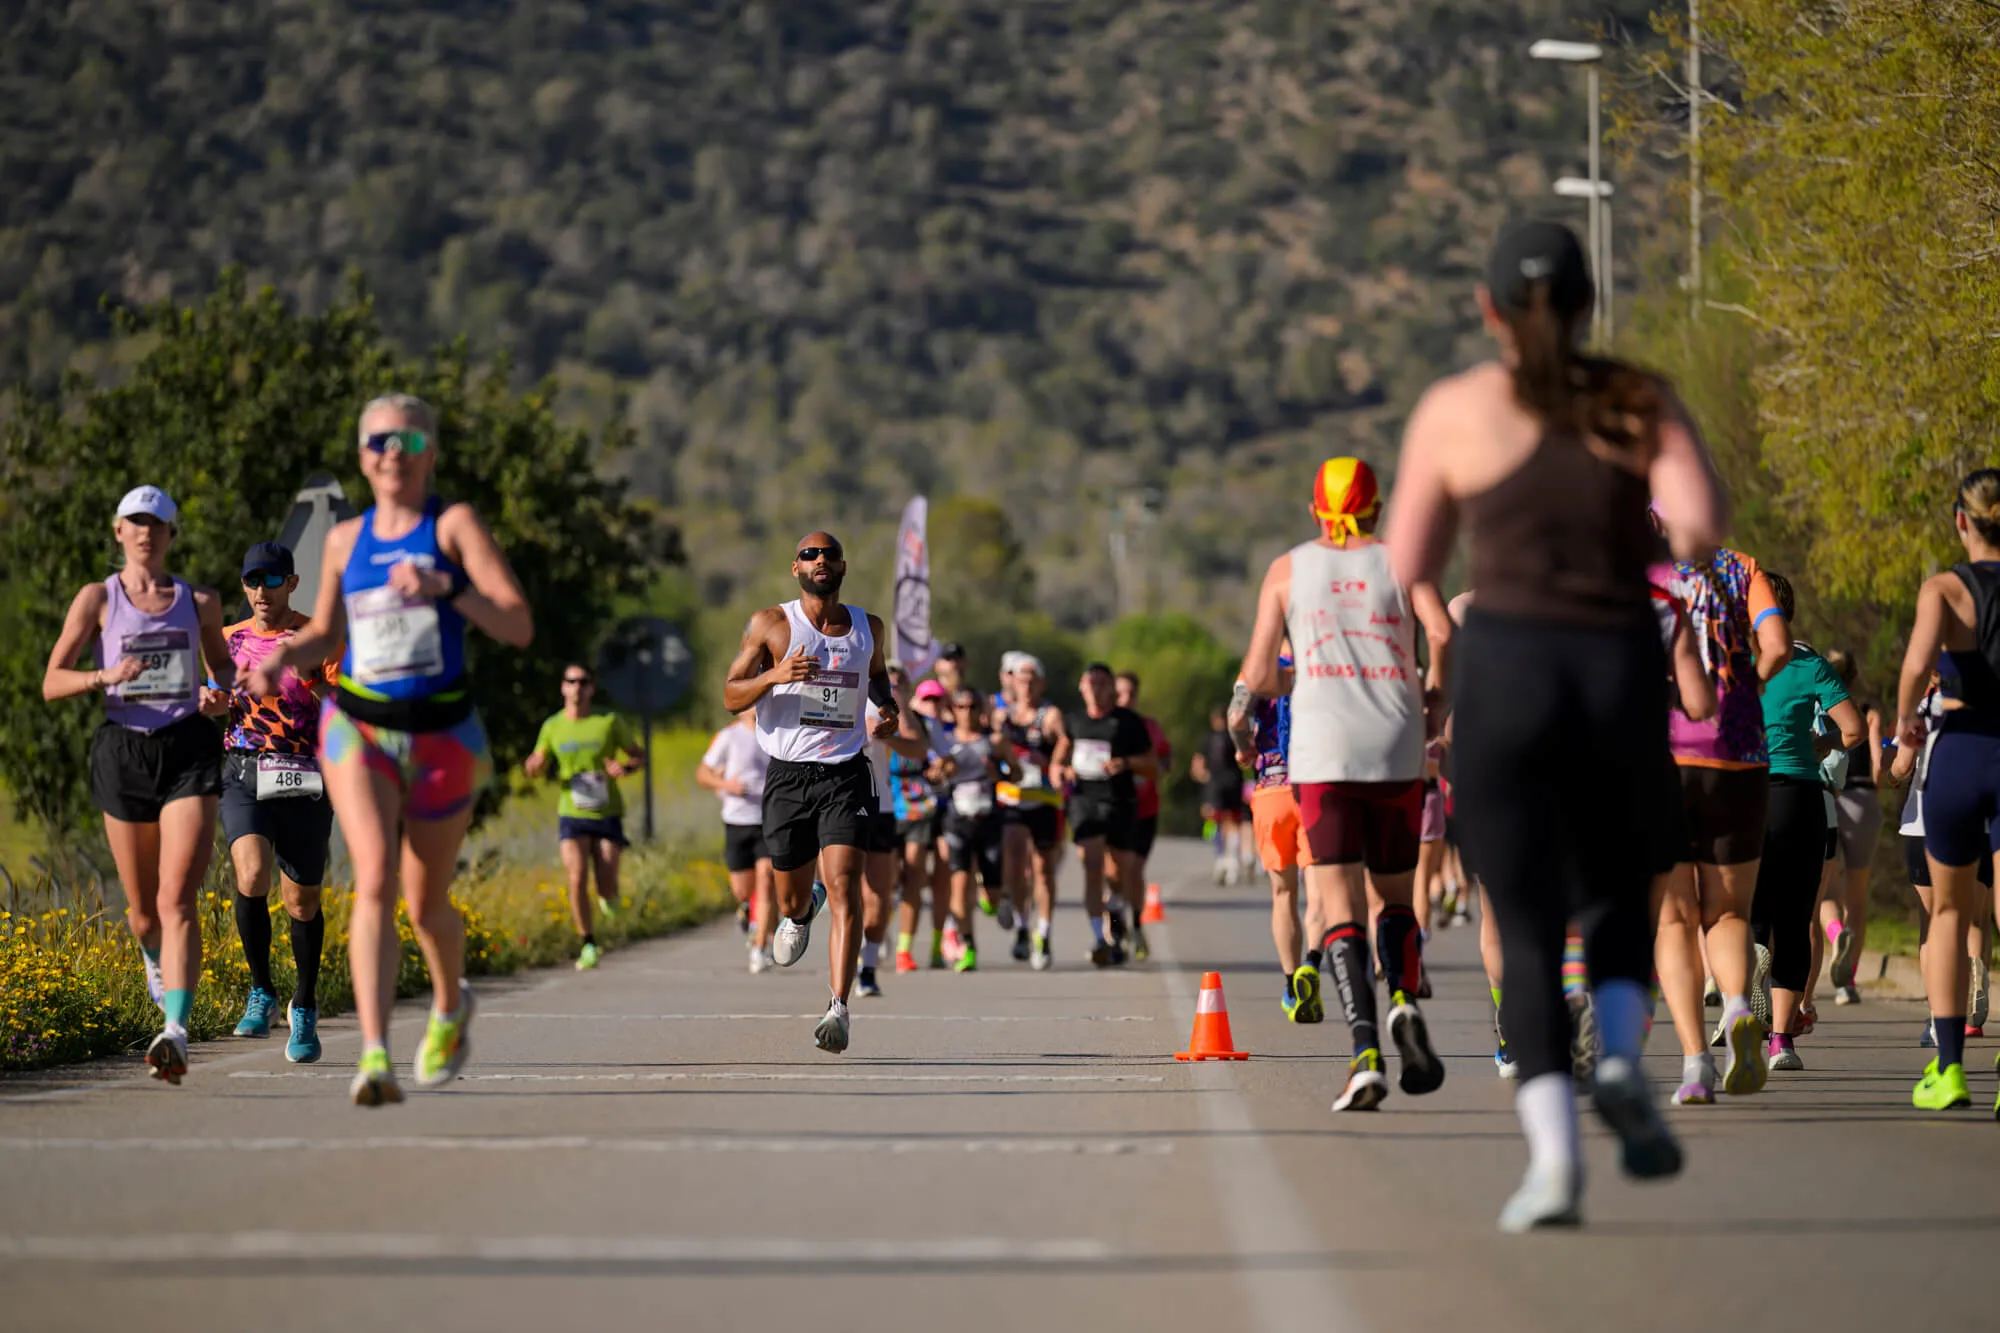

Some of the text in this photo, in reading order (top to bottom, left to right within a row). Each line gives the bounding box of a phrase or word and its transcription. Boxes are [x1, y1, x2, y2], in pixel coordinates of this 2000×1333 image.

[1308, 664, 1407, 681] VEGAS ALTAS
[823, 688, 838, 702] 91
[276, 772, 302, 786] 486
